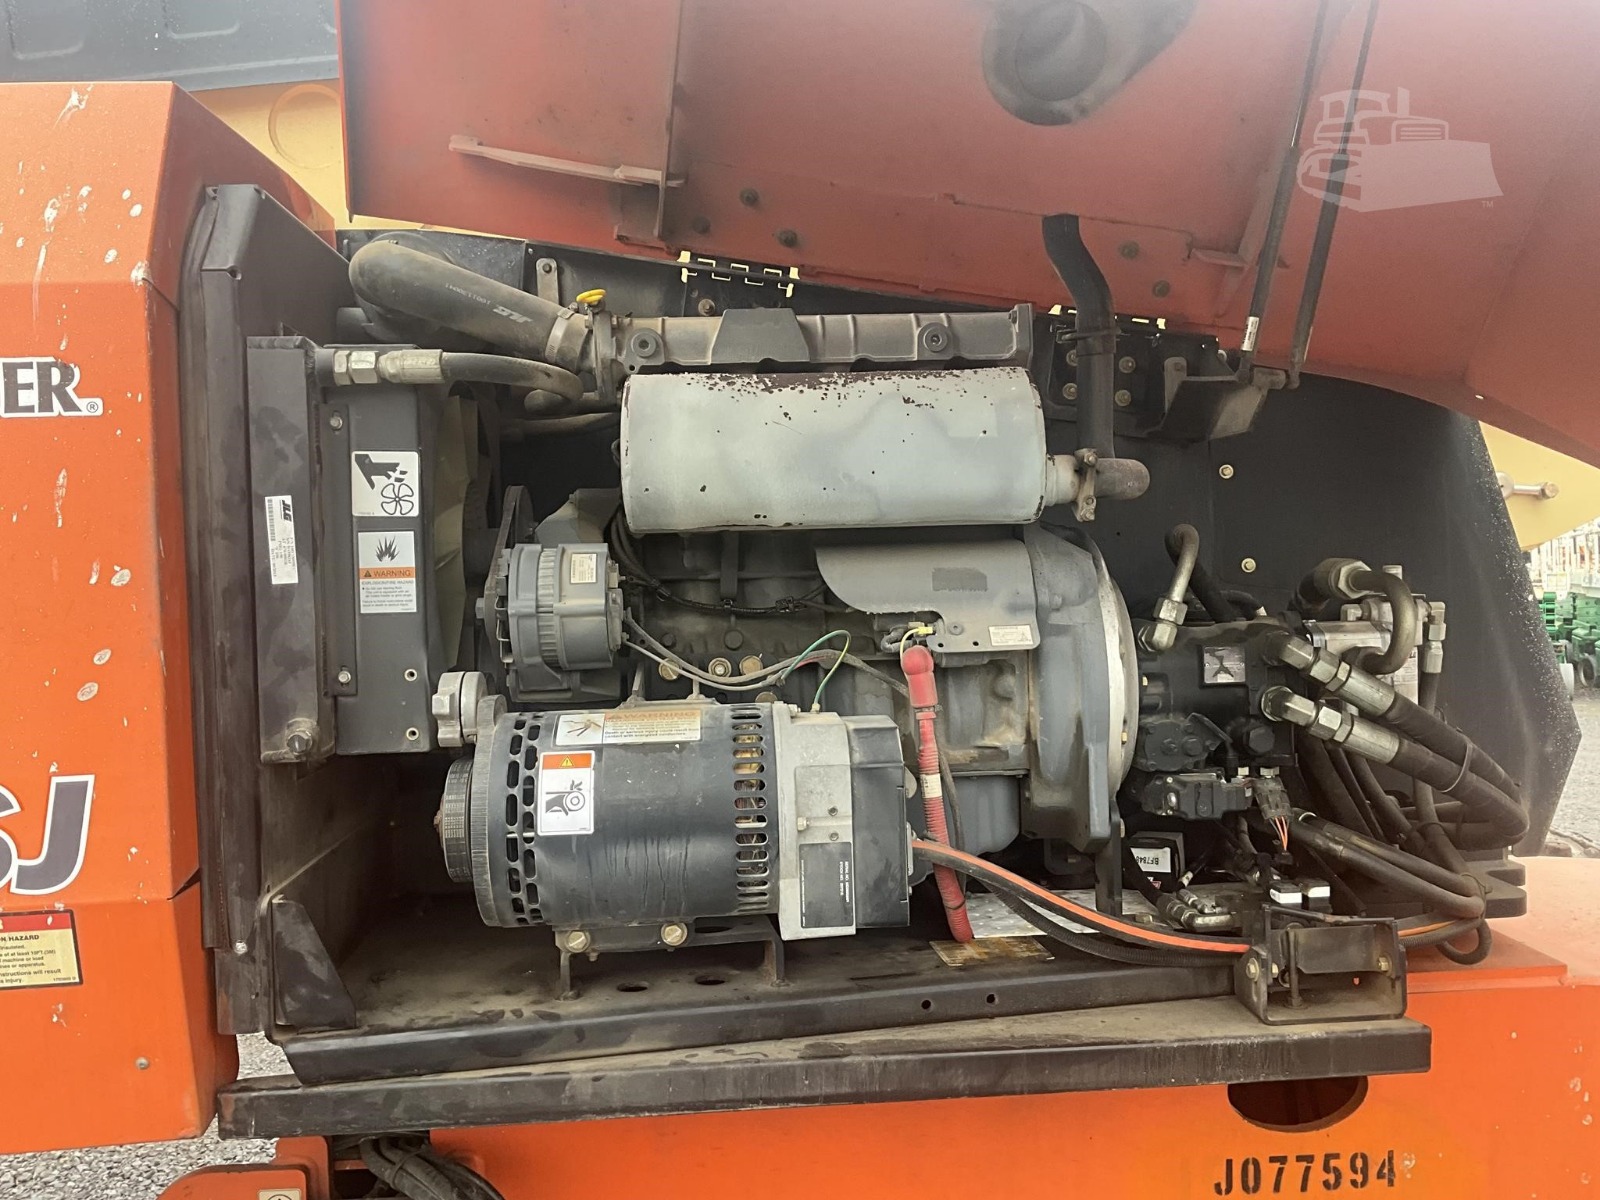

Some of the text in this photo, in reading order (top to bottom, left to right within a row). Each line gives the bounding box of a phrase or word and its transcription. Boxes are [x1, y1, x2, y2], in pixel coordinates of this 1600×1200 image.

[493, 304, 533, 323] JLG
[282, 500, 292, 522] JLG
[373, 569, 411, 577] WARNING
[1213, 1149, 1397, 1196] J077594
